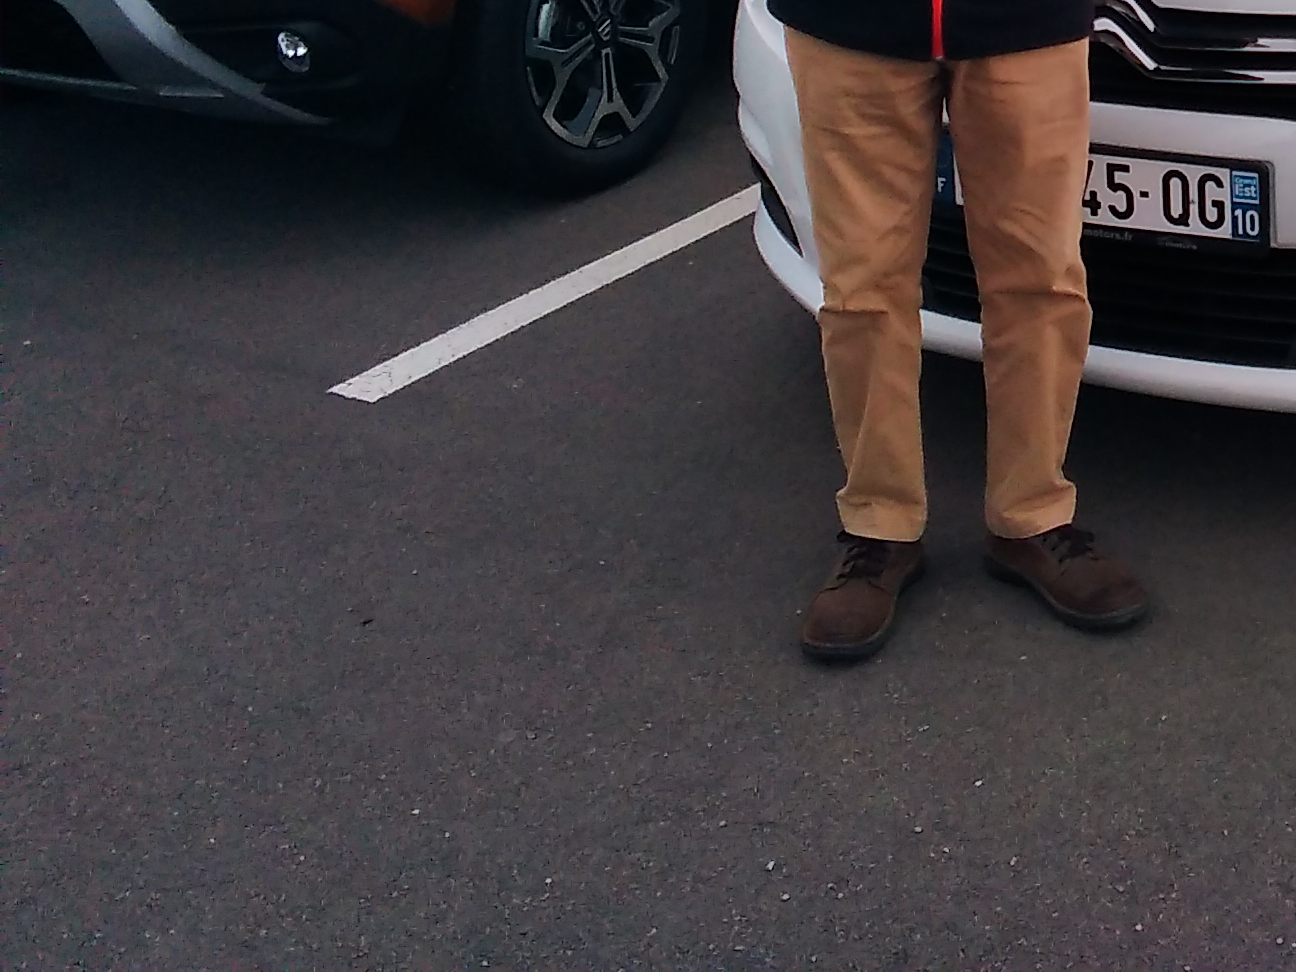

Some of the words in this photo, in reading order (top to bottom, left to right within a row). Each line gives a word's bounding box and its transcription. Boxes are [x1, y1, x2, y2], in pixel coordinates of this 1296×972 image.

[937, 176, 947, 193] F
[1235, 184, 1257, 198] Est
[1234, 208, 1260, 237] 10
